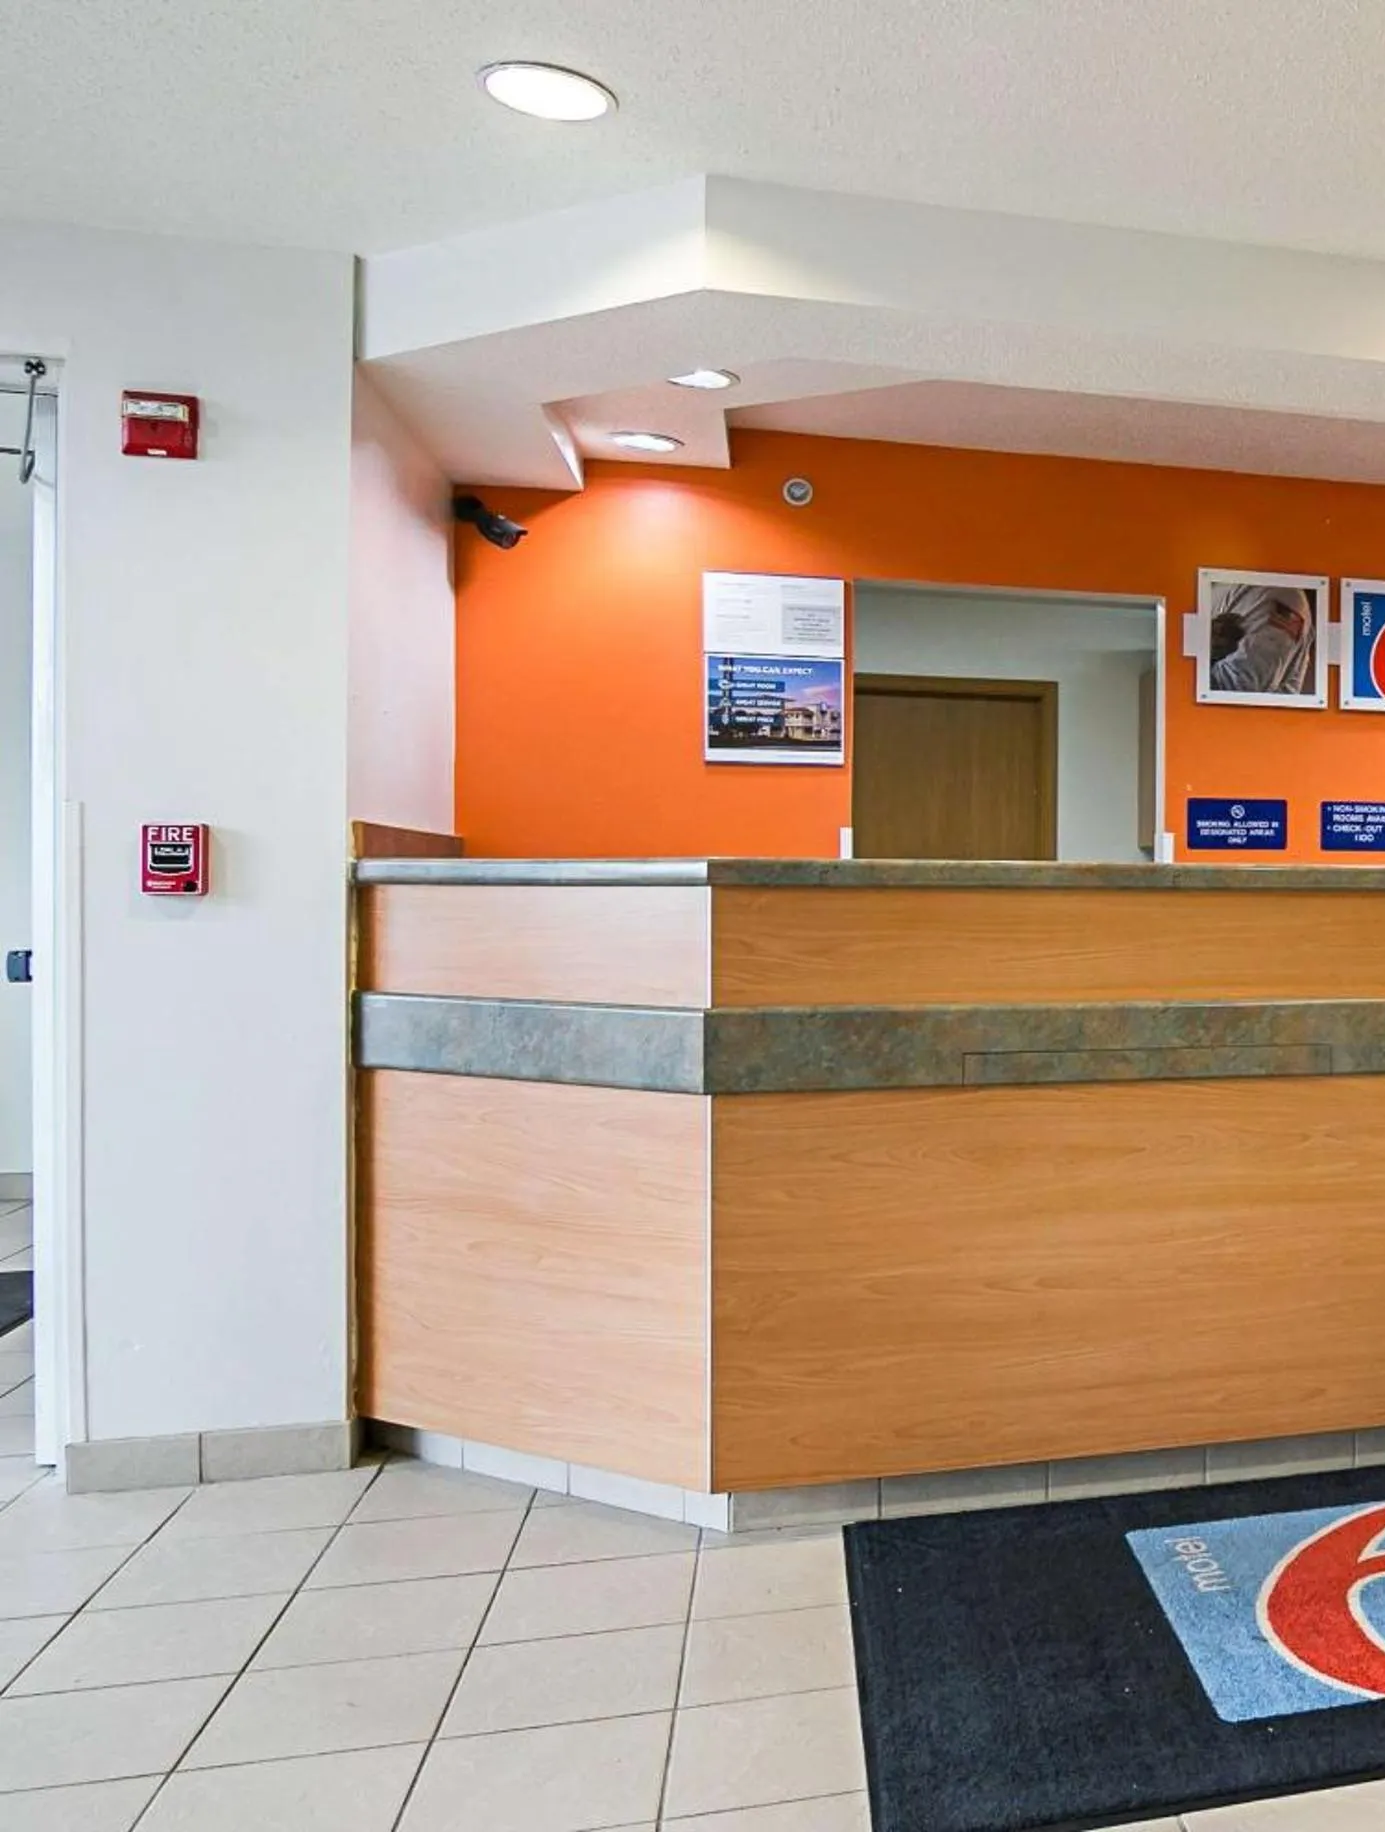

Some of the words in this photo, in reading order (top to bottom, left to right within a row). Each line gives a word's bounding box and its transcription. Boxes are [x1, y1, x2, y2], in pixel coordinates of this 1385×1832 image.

[1361, 601, 1372, 636] motel
[1333, 814, 1364, 822] ROOMS
[1196, 820, 1231, 828] SMOKING
[1233, 820, 1269, 828] ALLOWED
[147, 826, 194, 841] FIRE
[1200, 828, 1247, 836] DESIGNATED
[1249, 828, 1275, 836] AREAS
[1227, 836, 1247, 844] ONLY
[1164, 1536, 1231, 1593] motel
